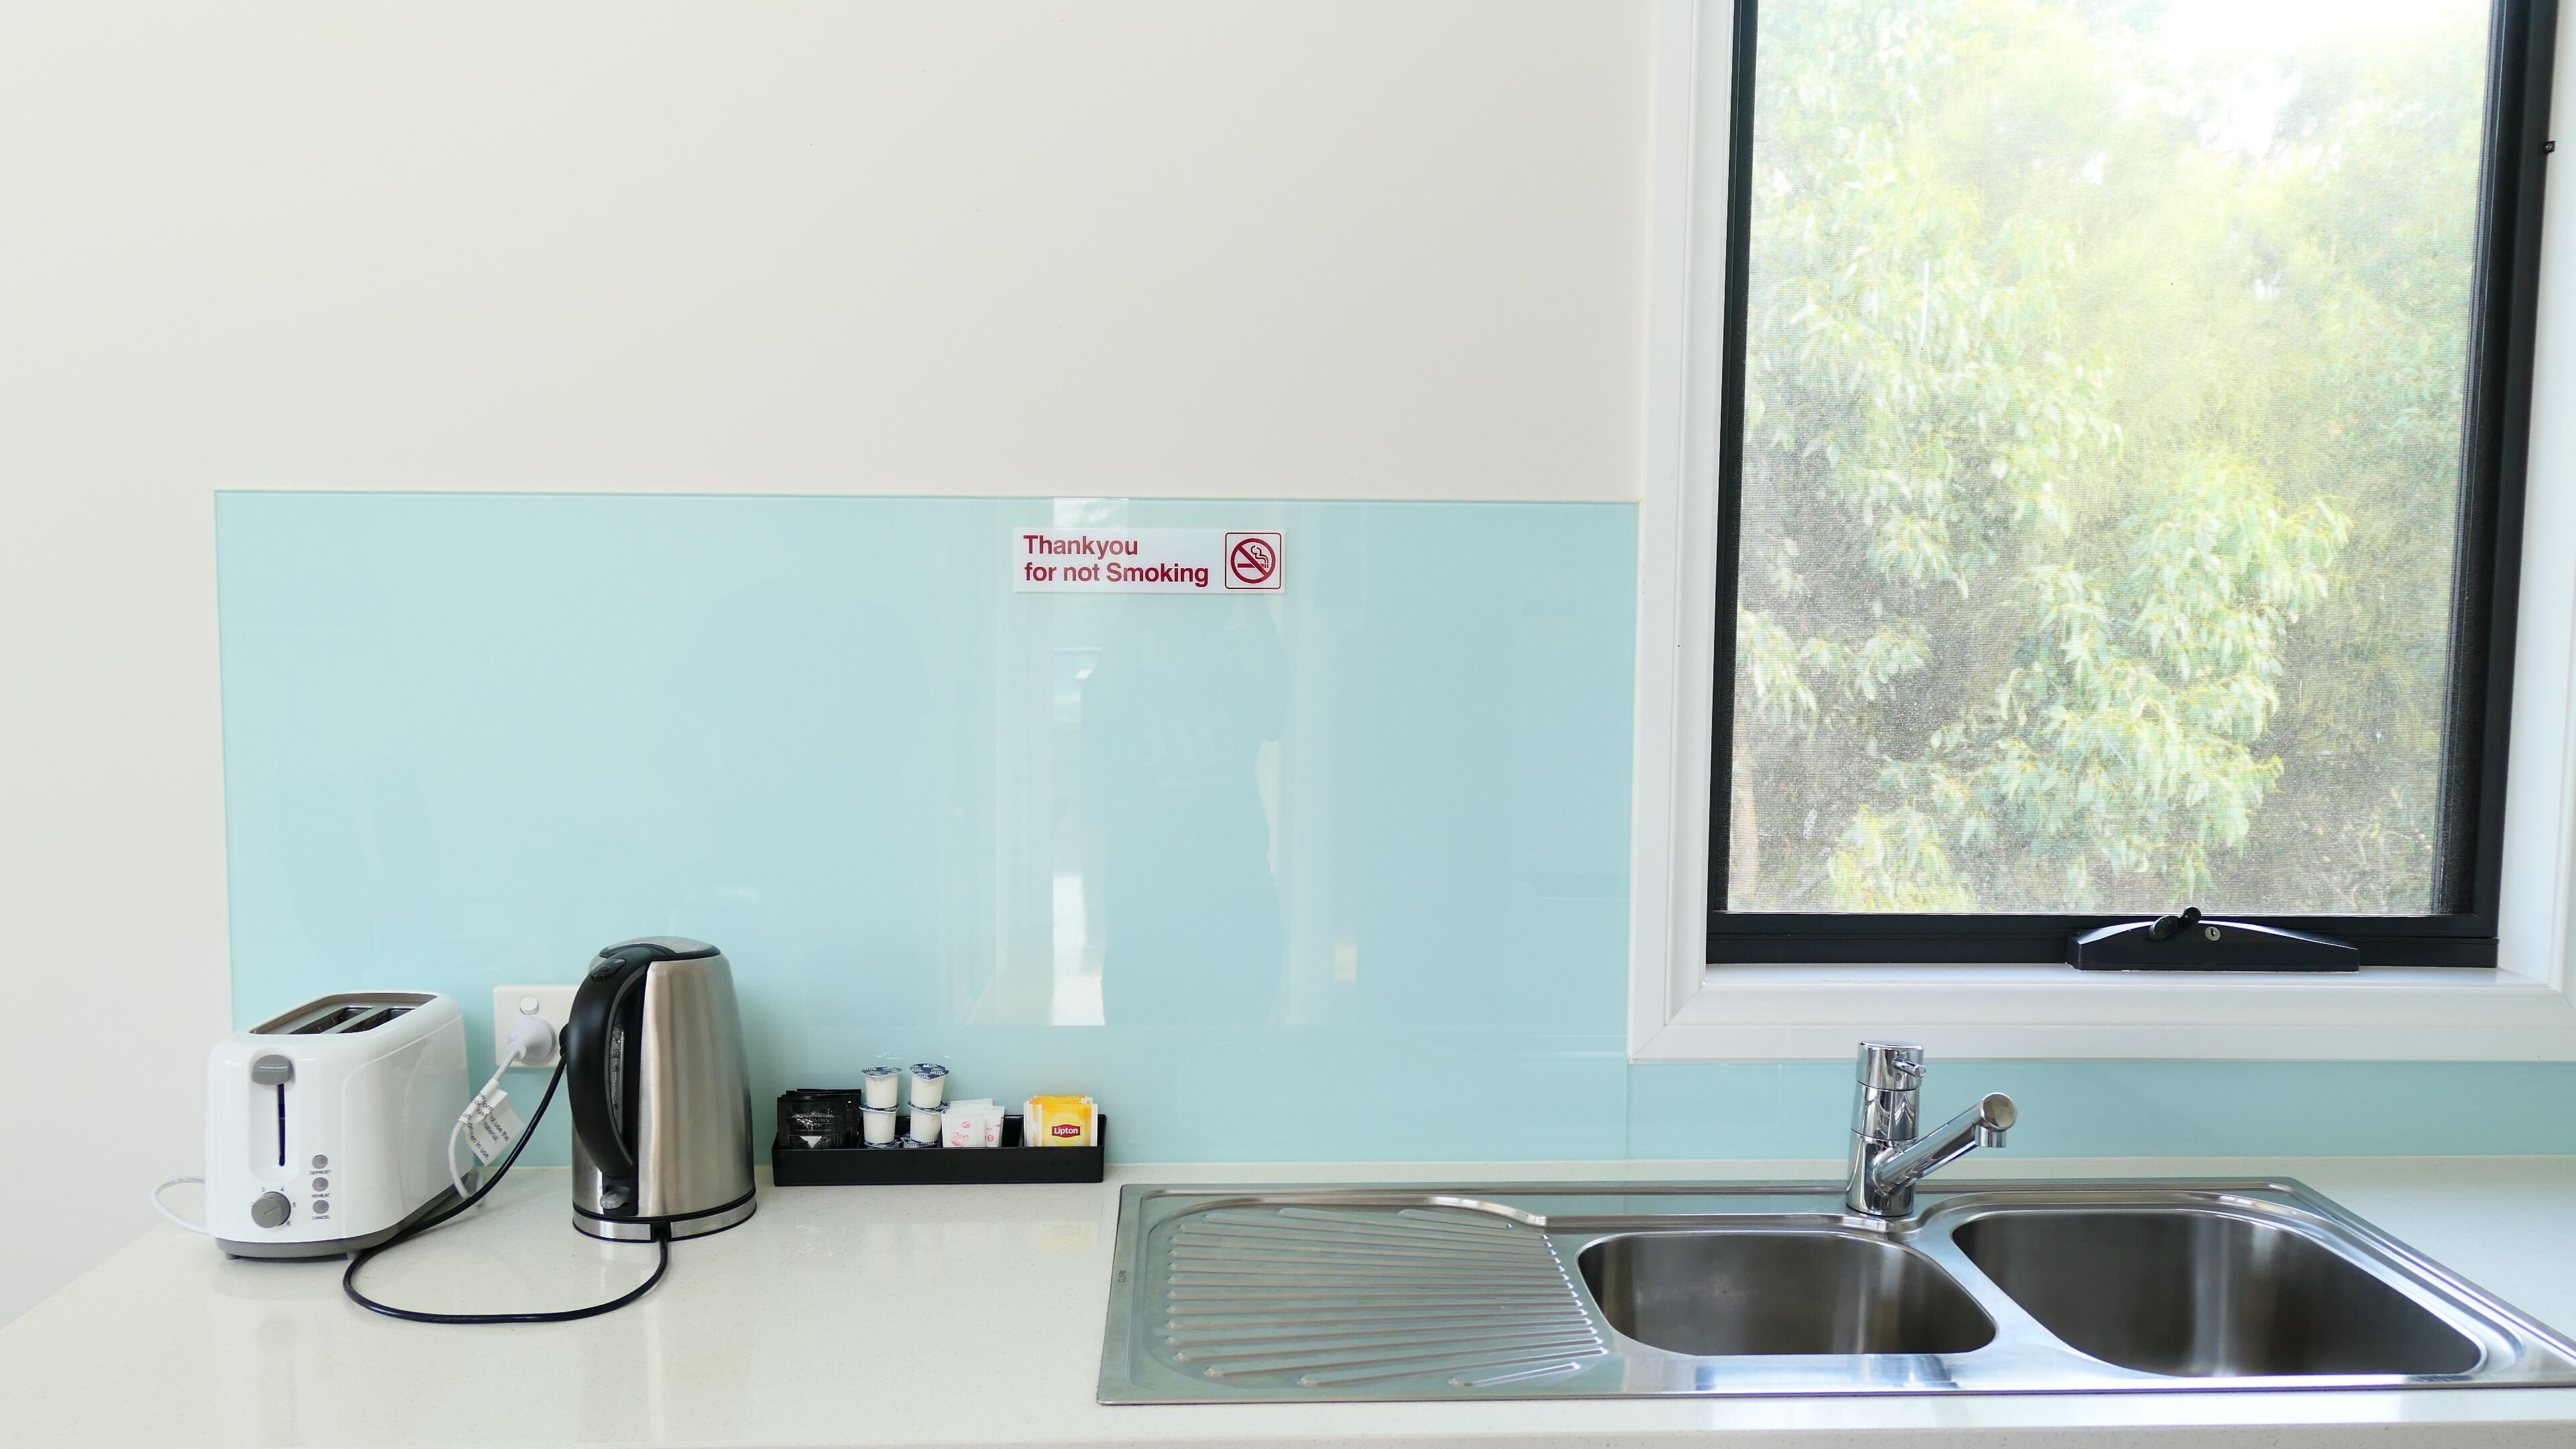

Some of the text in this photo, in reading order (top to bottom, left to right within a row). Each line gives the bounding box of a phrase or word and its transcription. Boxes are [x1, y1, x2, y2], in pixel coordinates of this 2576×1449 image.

[1023, 535, 1138, 560] Thankyou
[1024, 562, 1209, 588] for not Smoking
[494, 1122, 503, 1133] use
[501, 1130, 510, 1141] the
[1054, 1127, 1079, 1136] Lipton
